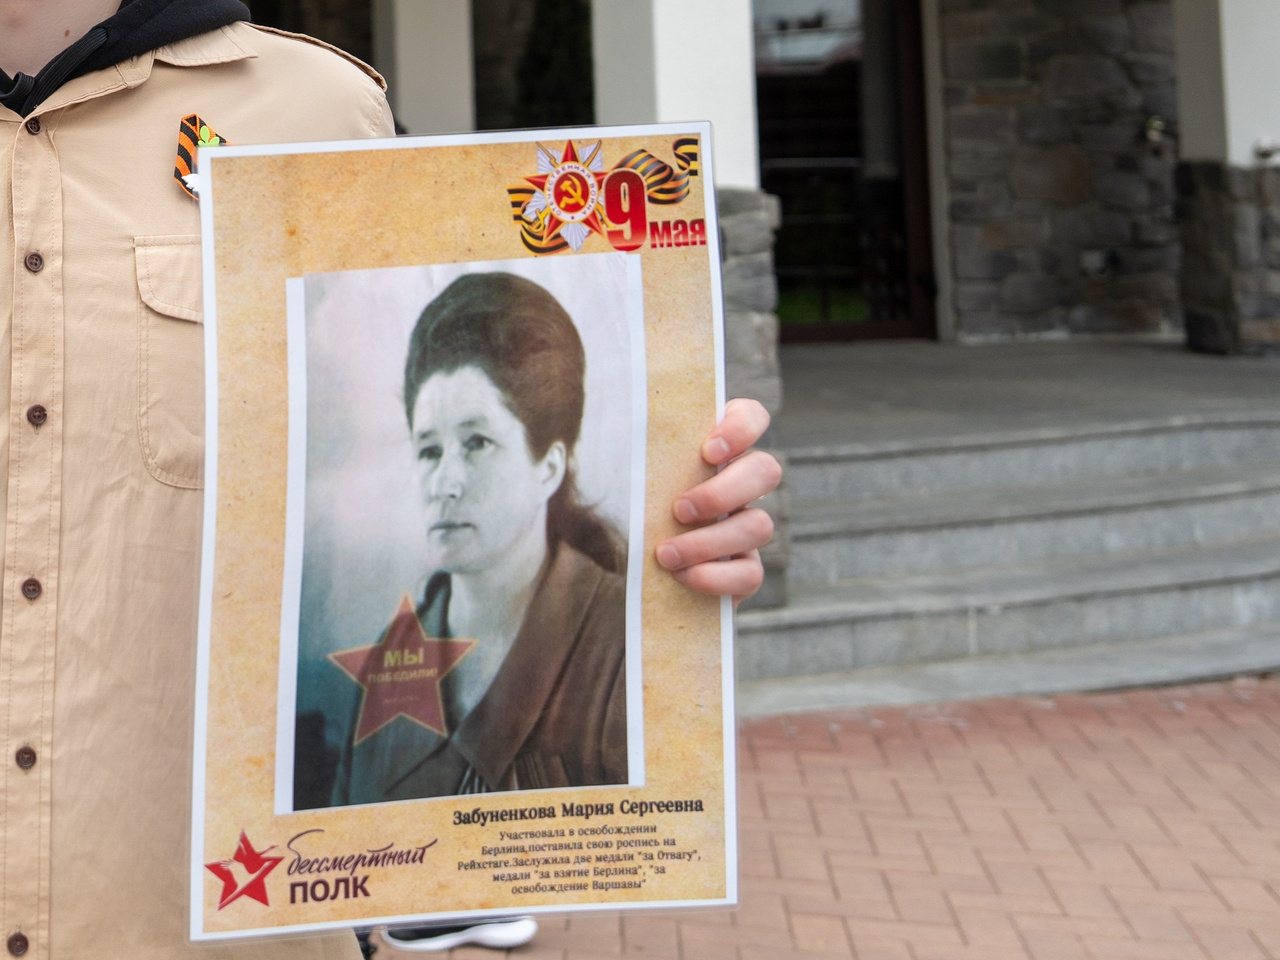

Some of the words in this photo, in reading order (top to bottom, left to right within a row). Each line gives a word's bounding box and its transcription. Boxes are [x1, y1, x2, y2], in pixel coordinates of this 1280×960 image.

[605, 170, 647, 251] 9
[649, 218, 707, 249] мая
[384, 648, 424, 667] МЫ
[453, 805, 555, 827] Забуненкова
[561, 802, 614, 820] Мария
[620, 798, 704, 816] Сергеевна
[499, 828, 565, 841] Участвовала
[578, 824, 657, 836] освобождении
[286, 829, 438, 876] бессмертный
[586, 840, 613, 849] свою
[616, 838, 659, 851] роспись
[663, 838, 676, 846] на
[573, 854, 591, 865] две
[595, 852, 634, 863] медали
[638, 851, 654, 861] "за
[492, 871, 530, 883] медали
[535, 869, 550, 880] "за
[554, 868, 590, 878] взятие
[649, 864, 666, 874] "за
[289, 874, 370, 904] ПОЛК
[512, 881, 589, 894] освобождение
[592, 879, 646, 890] Варшавы"
